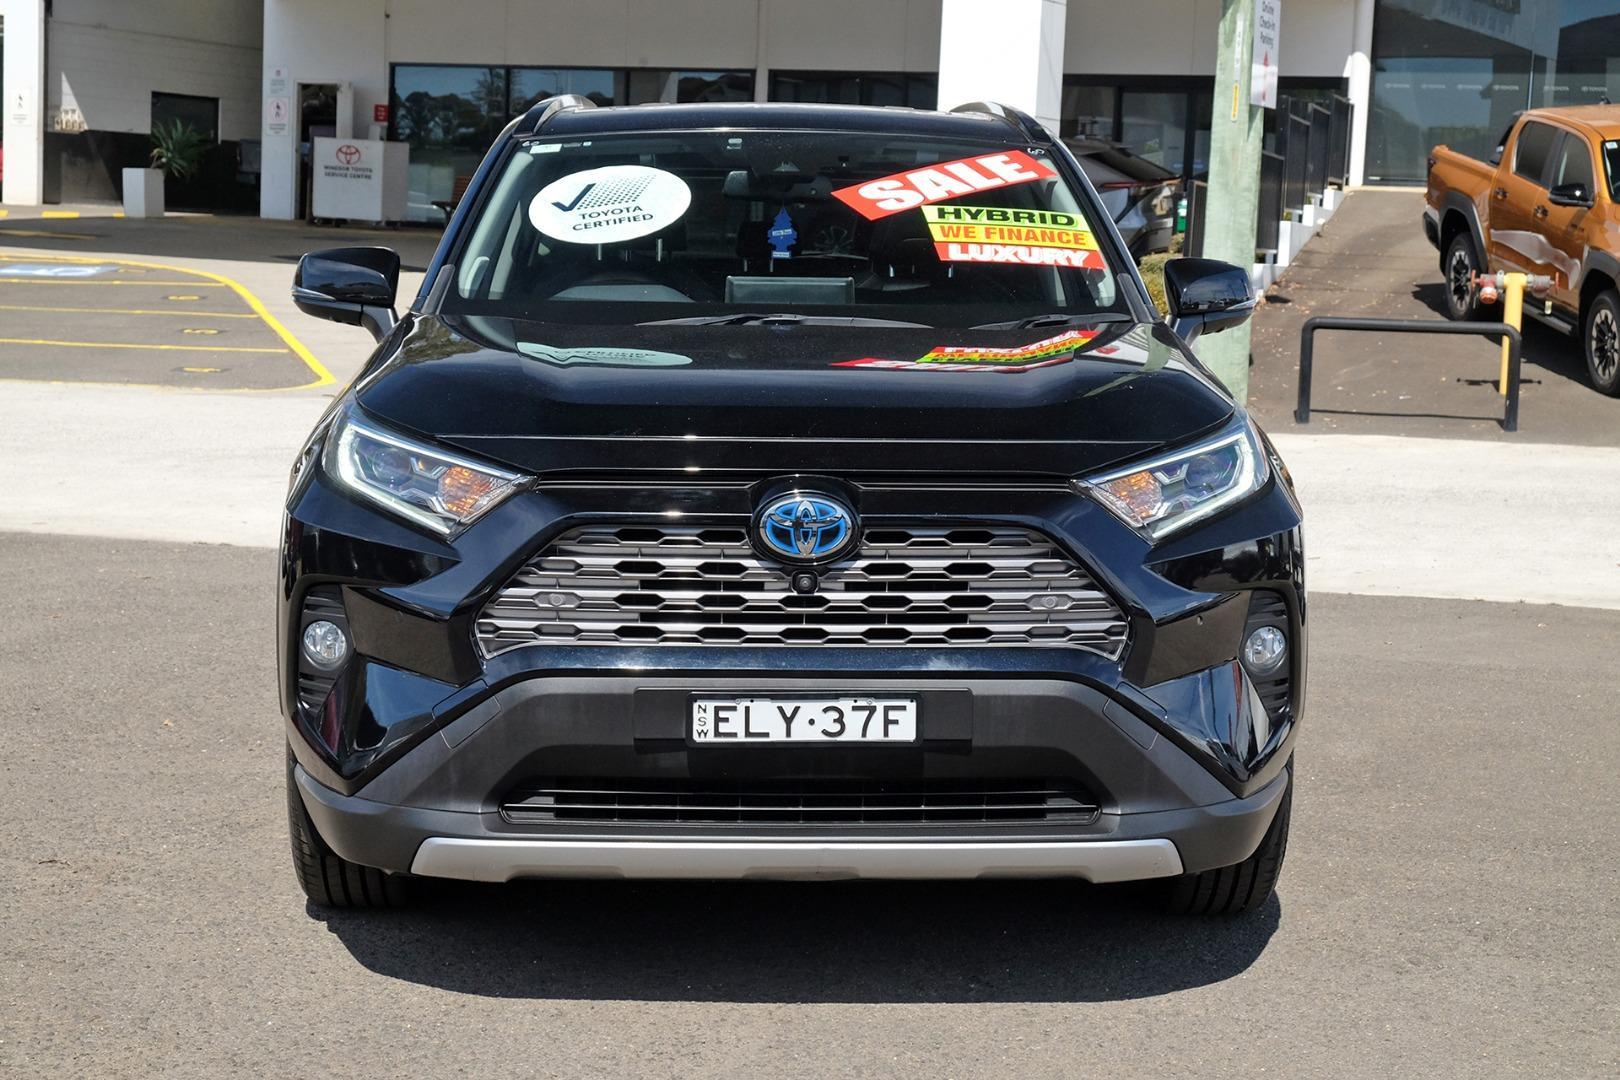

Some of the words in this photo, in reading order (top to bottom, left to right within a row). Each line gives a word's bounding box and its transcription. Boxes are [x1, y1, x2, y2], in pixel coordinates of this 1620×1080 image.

[858, 154, 1040, 211] SALE
[572, 213, 654, 231] CERTIFIED
[580, 205, 643, 220] TOYOTA
[937, 206, 1076, 227] HYBRID
[940, 225, 979, 239] WE
[984, 226, 1087, 246] FINANCE
[947, 243, 1091, 267] LUXURY
